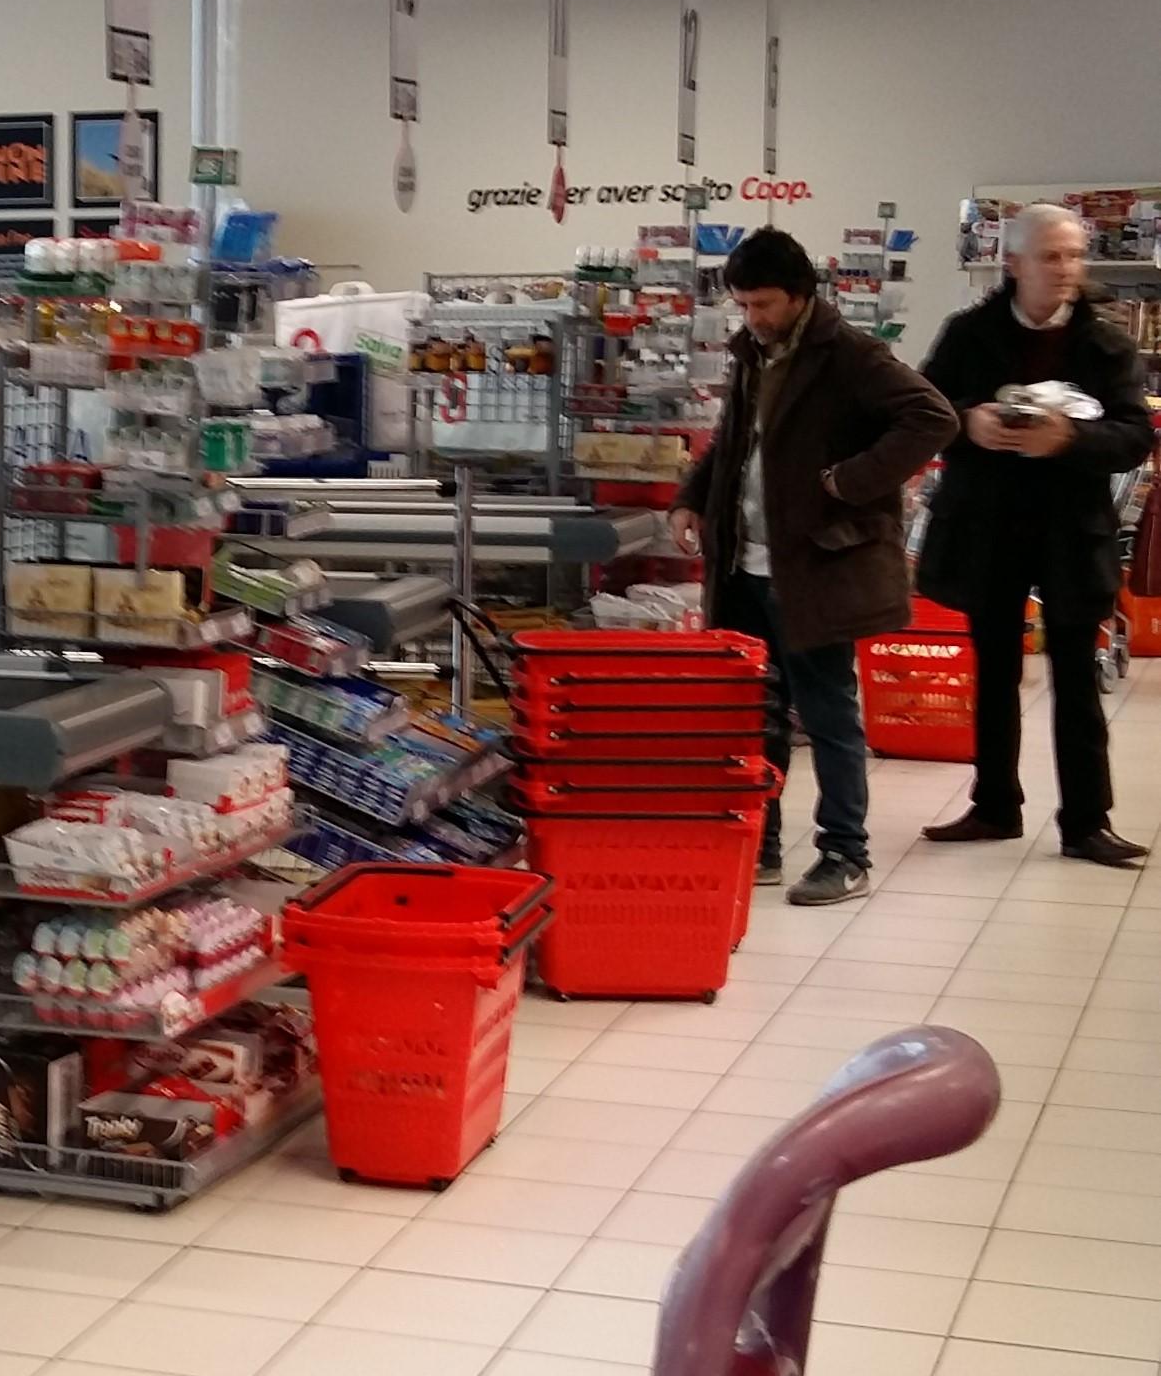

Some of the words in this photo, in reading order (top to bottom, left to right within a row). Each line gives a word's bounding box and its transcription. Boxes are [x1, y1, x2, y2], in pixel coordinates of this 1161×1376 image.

[467, 182, 542, 212] grazie
[547, 185, 591, 211] er
[596, 183, 652, 204] aver
[658, 176, 732, 203] scto
[740, 176, 813, 207] Coop.
[85, 1114, 140, 1142] Tronky
